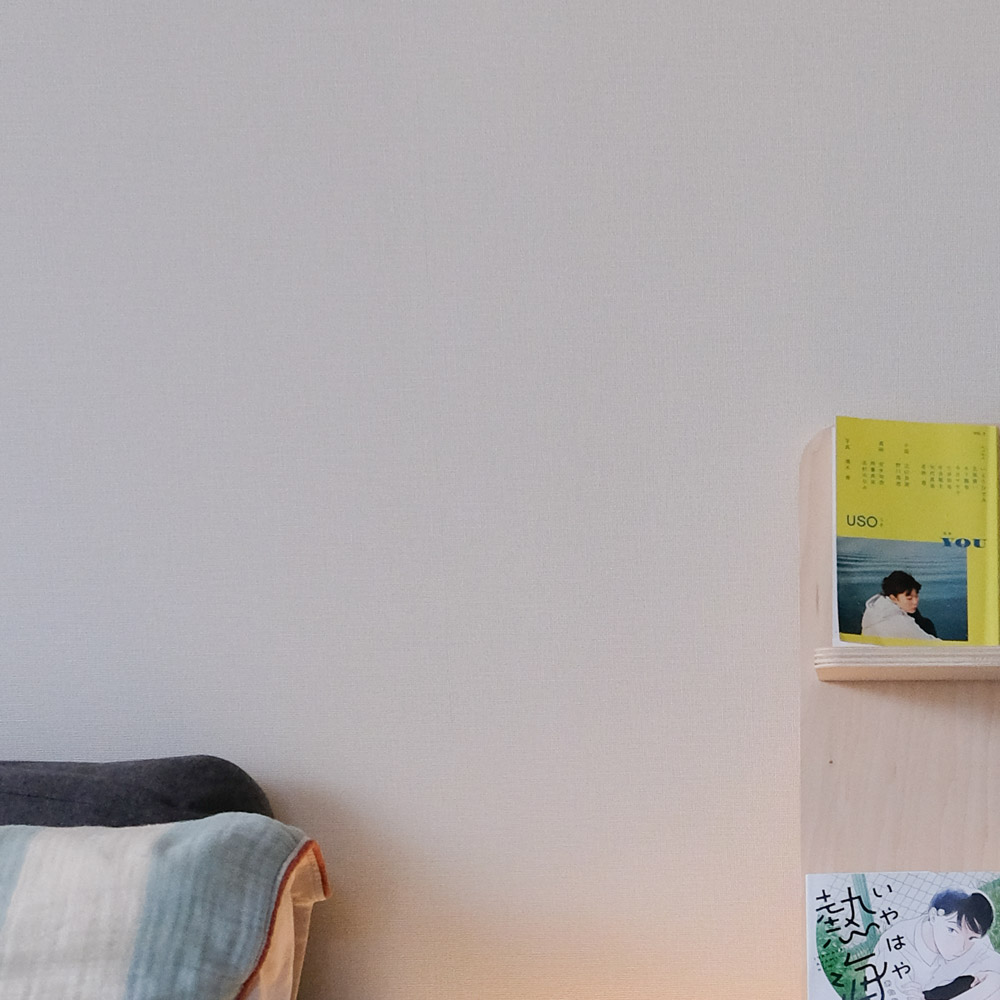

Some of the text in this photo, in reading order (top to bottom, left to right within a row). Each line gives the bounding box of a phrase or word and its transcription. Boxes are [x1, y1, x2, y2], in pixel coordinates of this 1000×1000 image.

[846, 514, 878, 528] USO
[941, 537, 988, 549] YOU
[873, 884, 912, 980] いやはや
